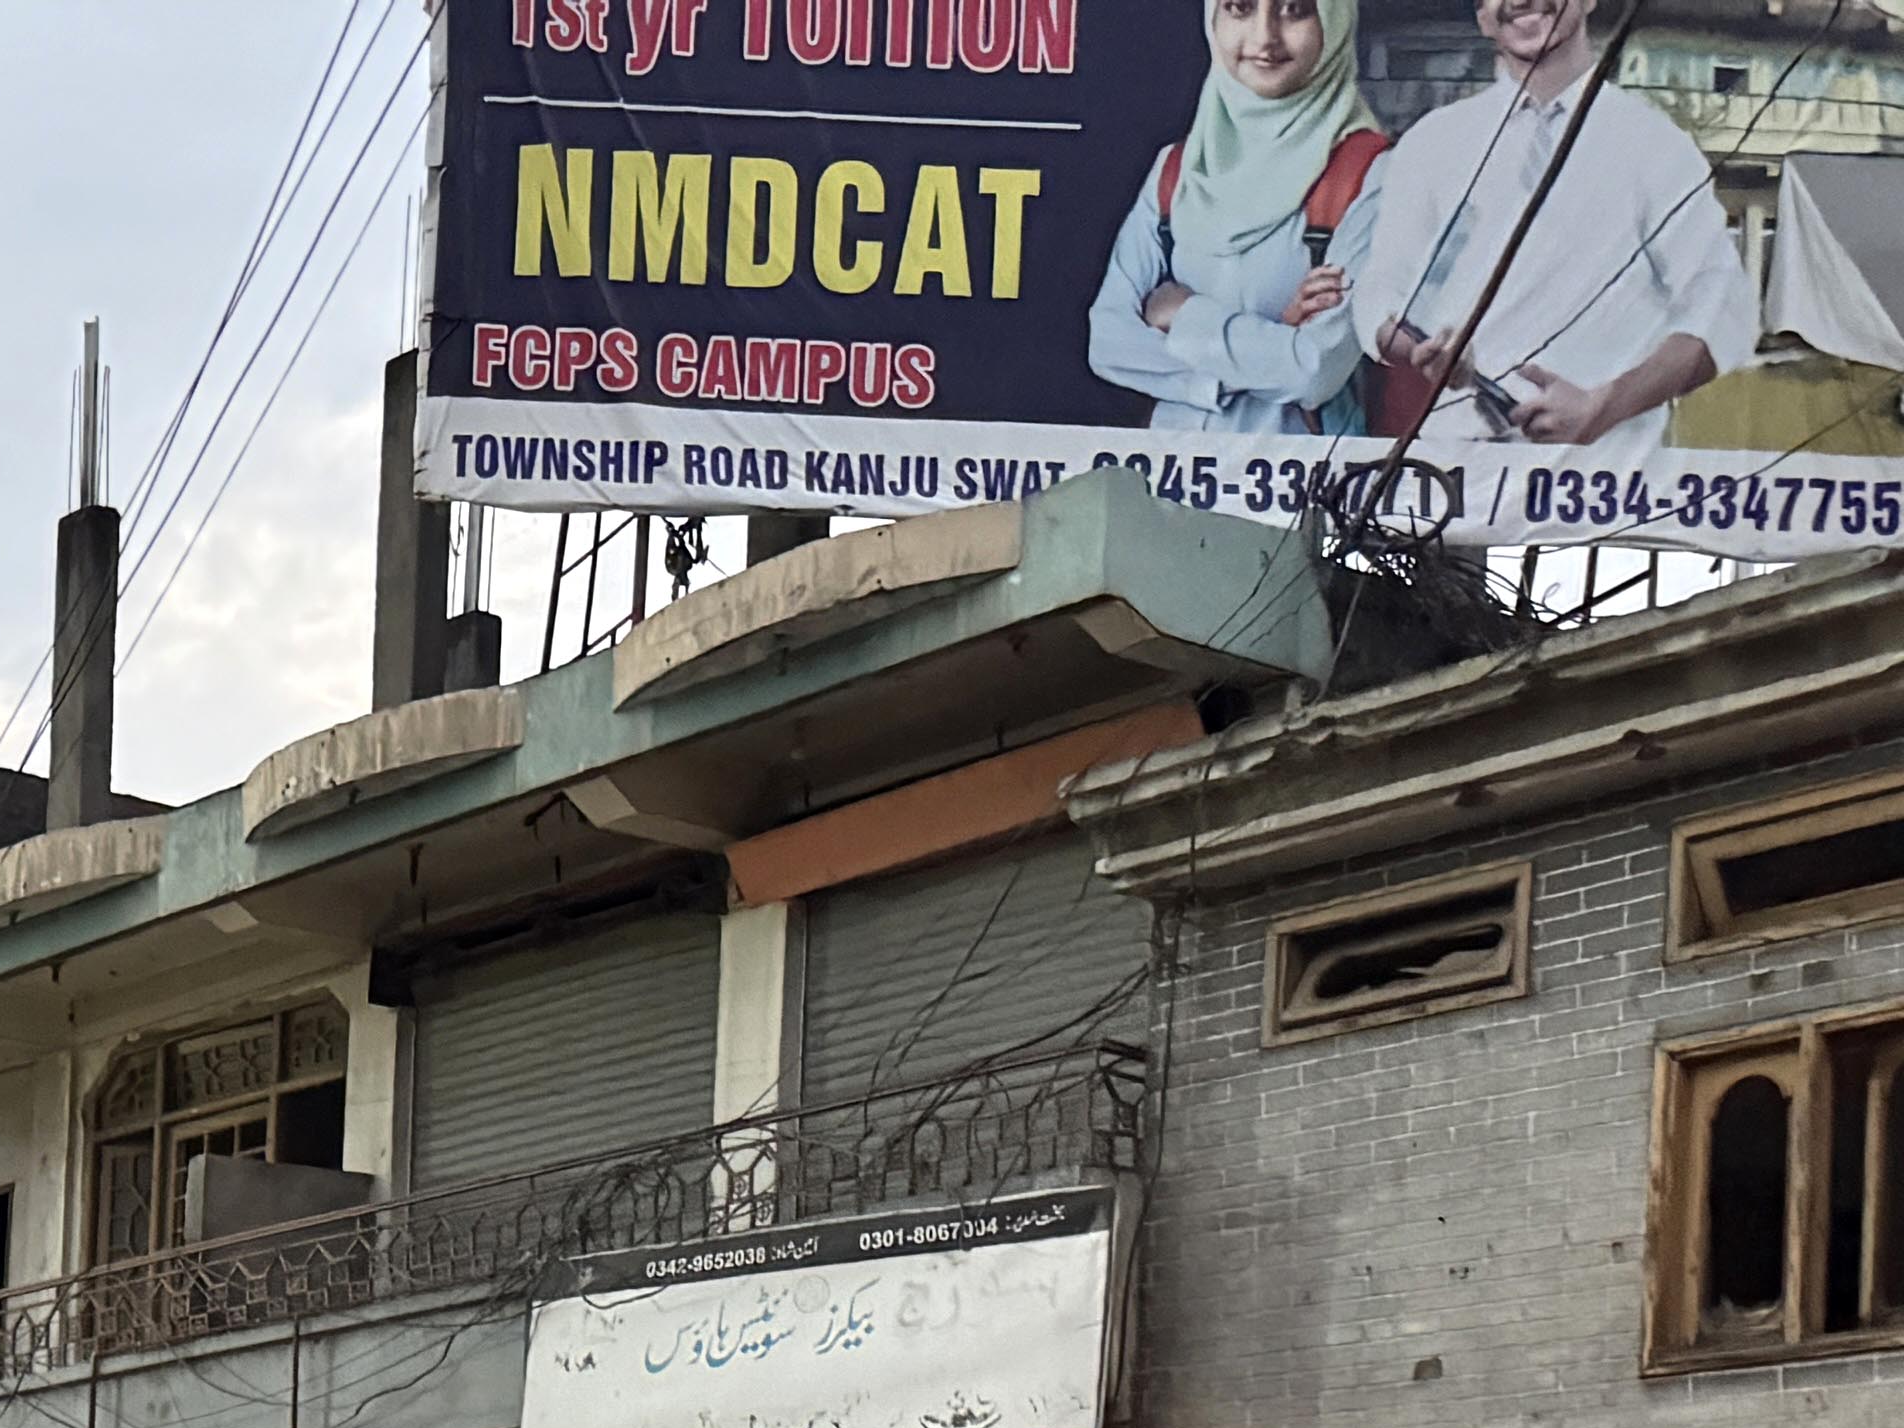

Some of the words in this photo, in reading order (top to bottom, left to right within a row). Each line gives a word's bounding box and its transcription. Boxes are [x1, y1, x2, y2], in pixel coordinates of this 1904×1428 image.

[513, 143, 1041, 299] NMDCAT
[473, 324, 638, 391] FCPS
[656, 333, 935, 408] CAMPUS
[452, 434, 669, 484] TOWNSHIP
[684, 444, 788, 490] ROAD
[804, 450, 940, 498] KANJU
[954, 456, 1066, 503] SWAT
